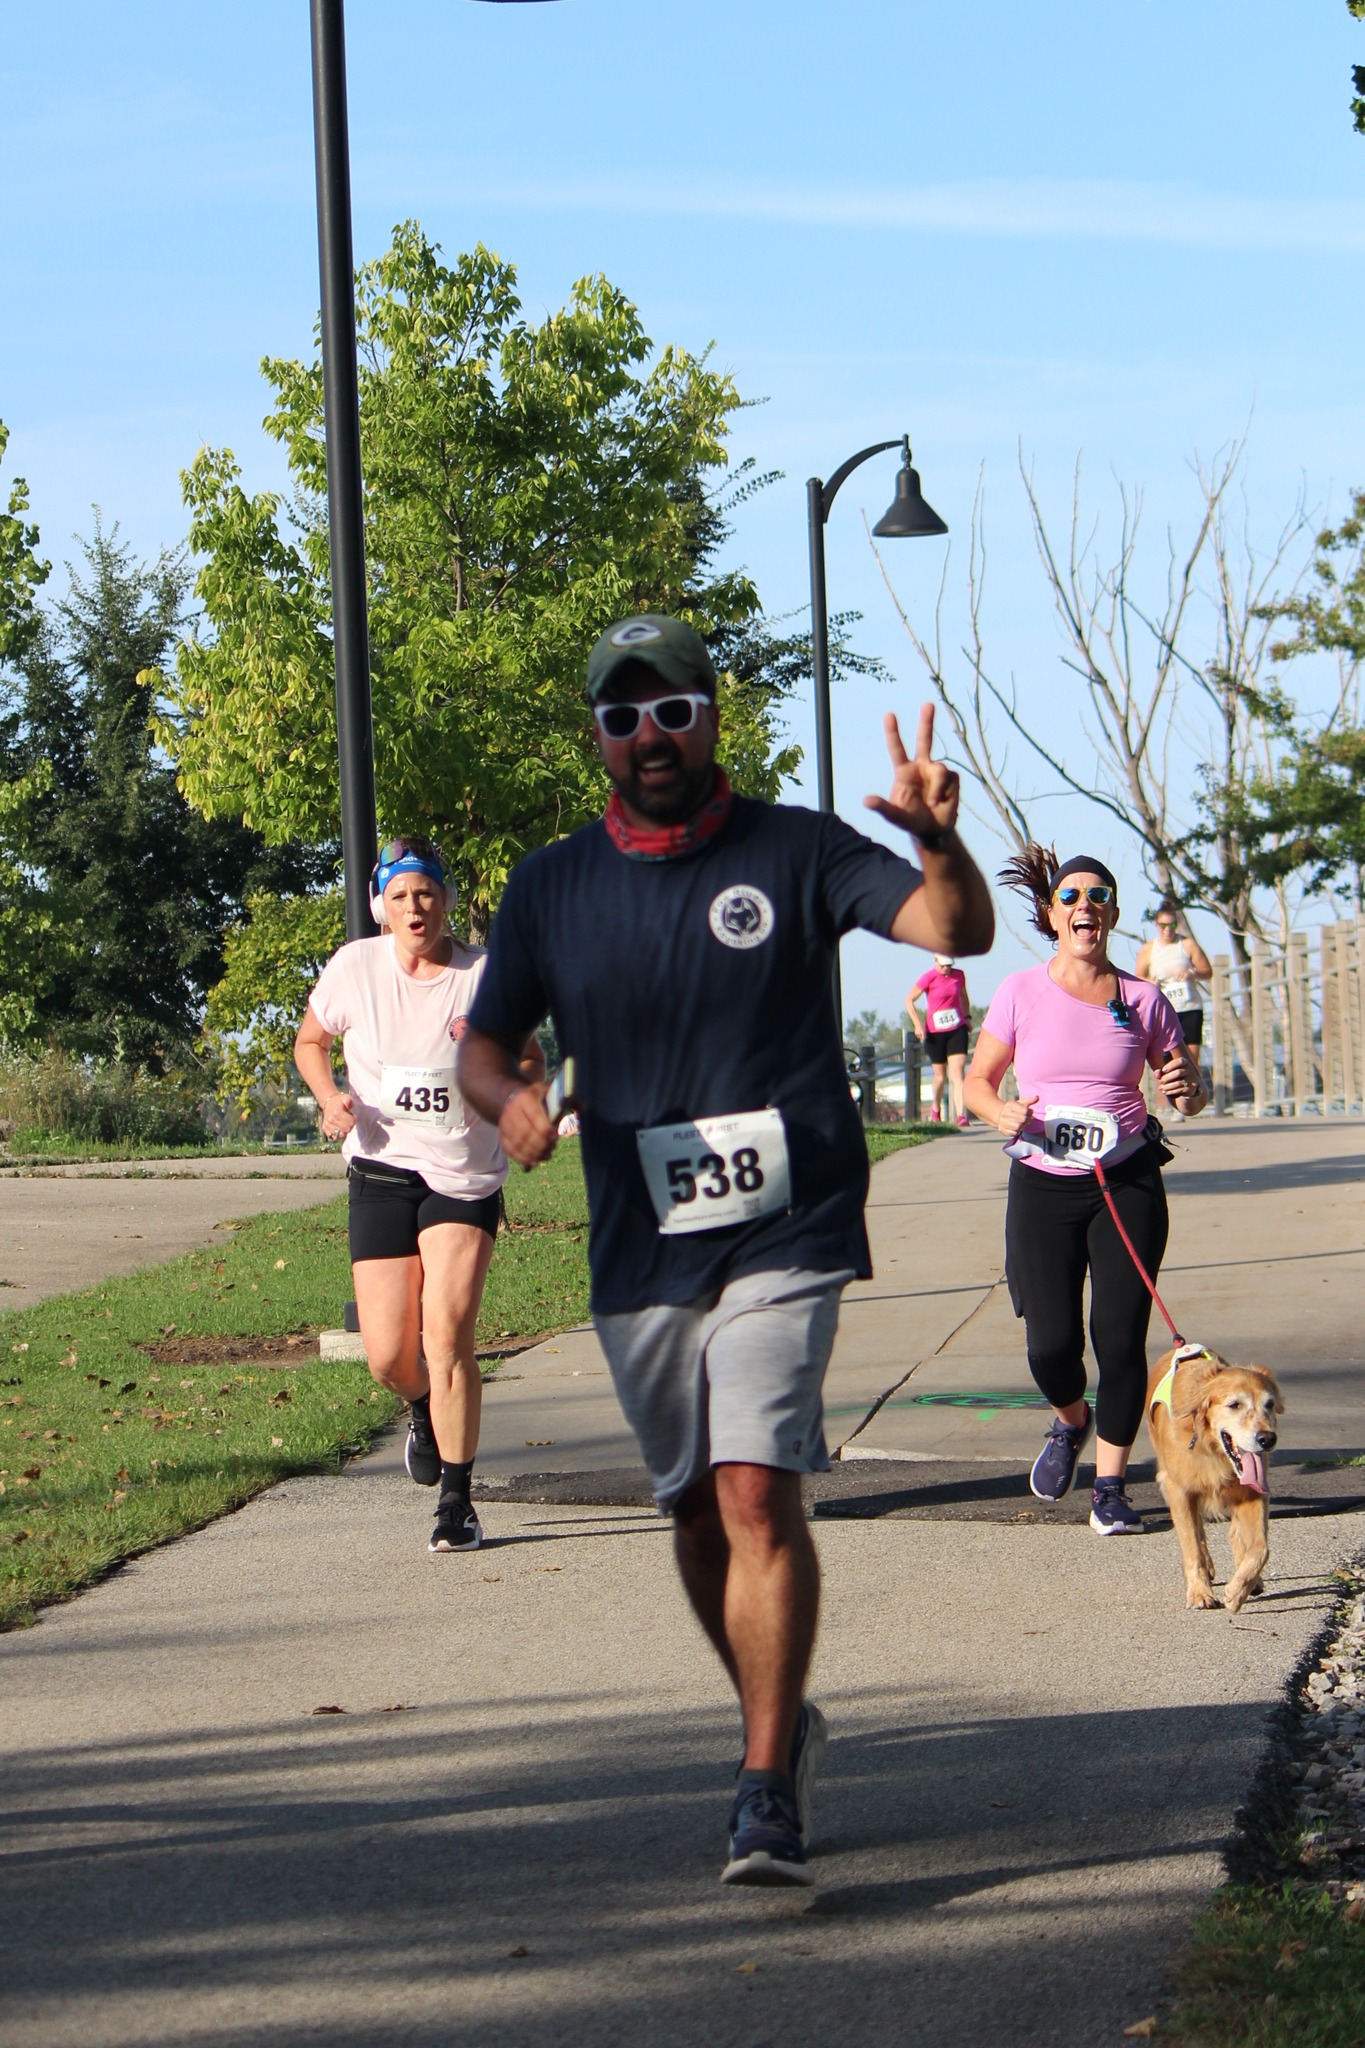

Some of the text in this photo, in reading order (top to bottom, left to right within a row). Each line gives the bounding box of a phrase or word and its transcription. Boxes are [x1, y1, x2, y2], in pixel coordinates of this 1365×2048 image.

[395, 1086, 450, 1113] 435
[1055, 1122, 1104, 1152] 680
[665, 1147, 765, 1204] 538
